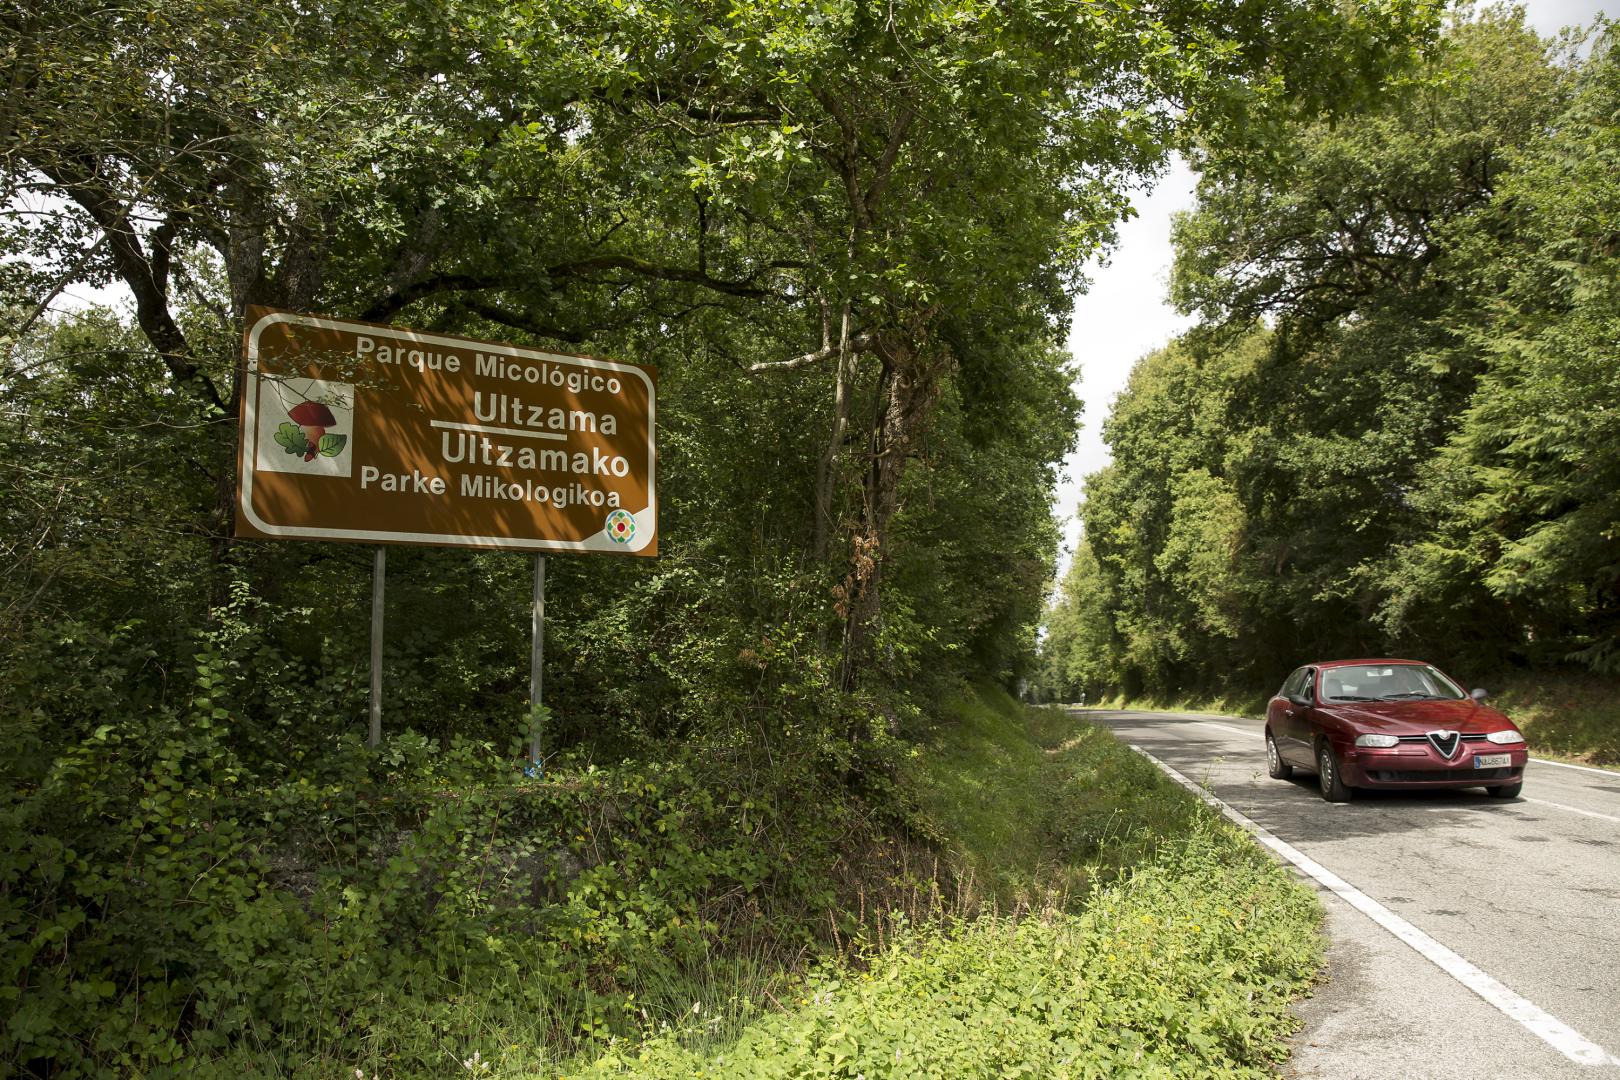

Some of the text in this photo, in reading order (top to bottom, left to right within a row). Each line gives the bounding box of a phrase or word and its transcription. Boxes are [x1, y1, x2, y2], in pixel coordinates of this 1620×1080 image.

[356, 336, 621, 394] Parque Micológico
[474, 391, 617, 435] Ultzama
[441, 431, 630, 478] Ultzamako
[360, 465, 621, 509] Parke Mikologikoa
